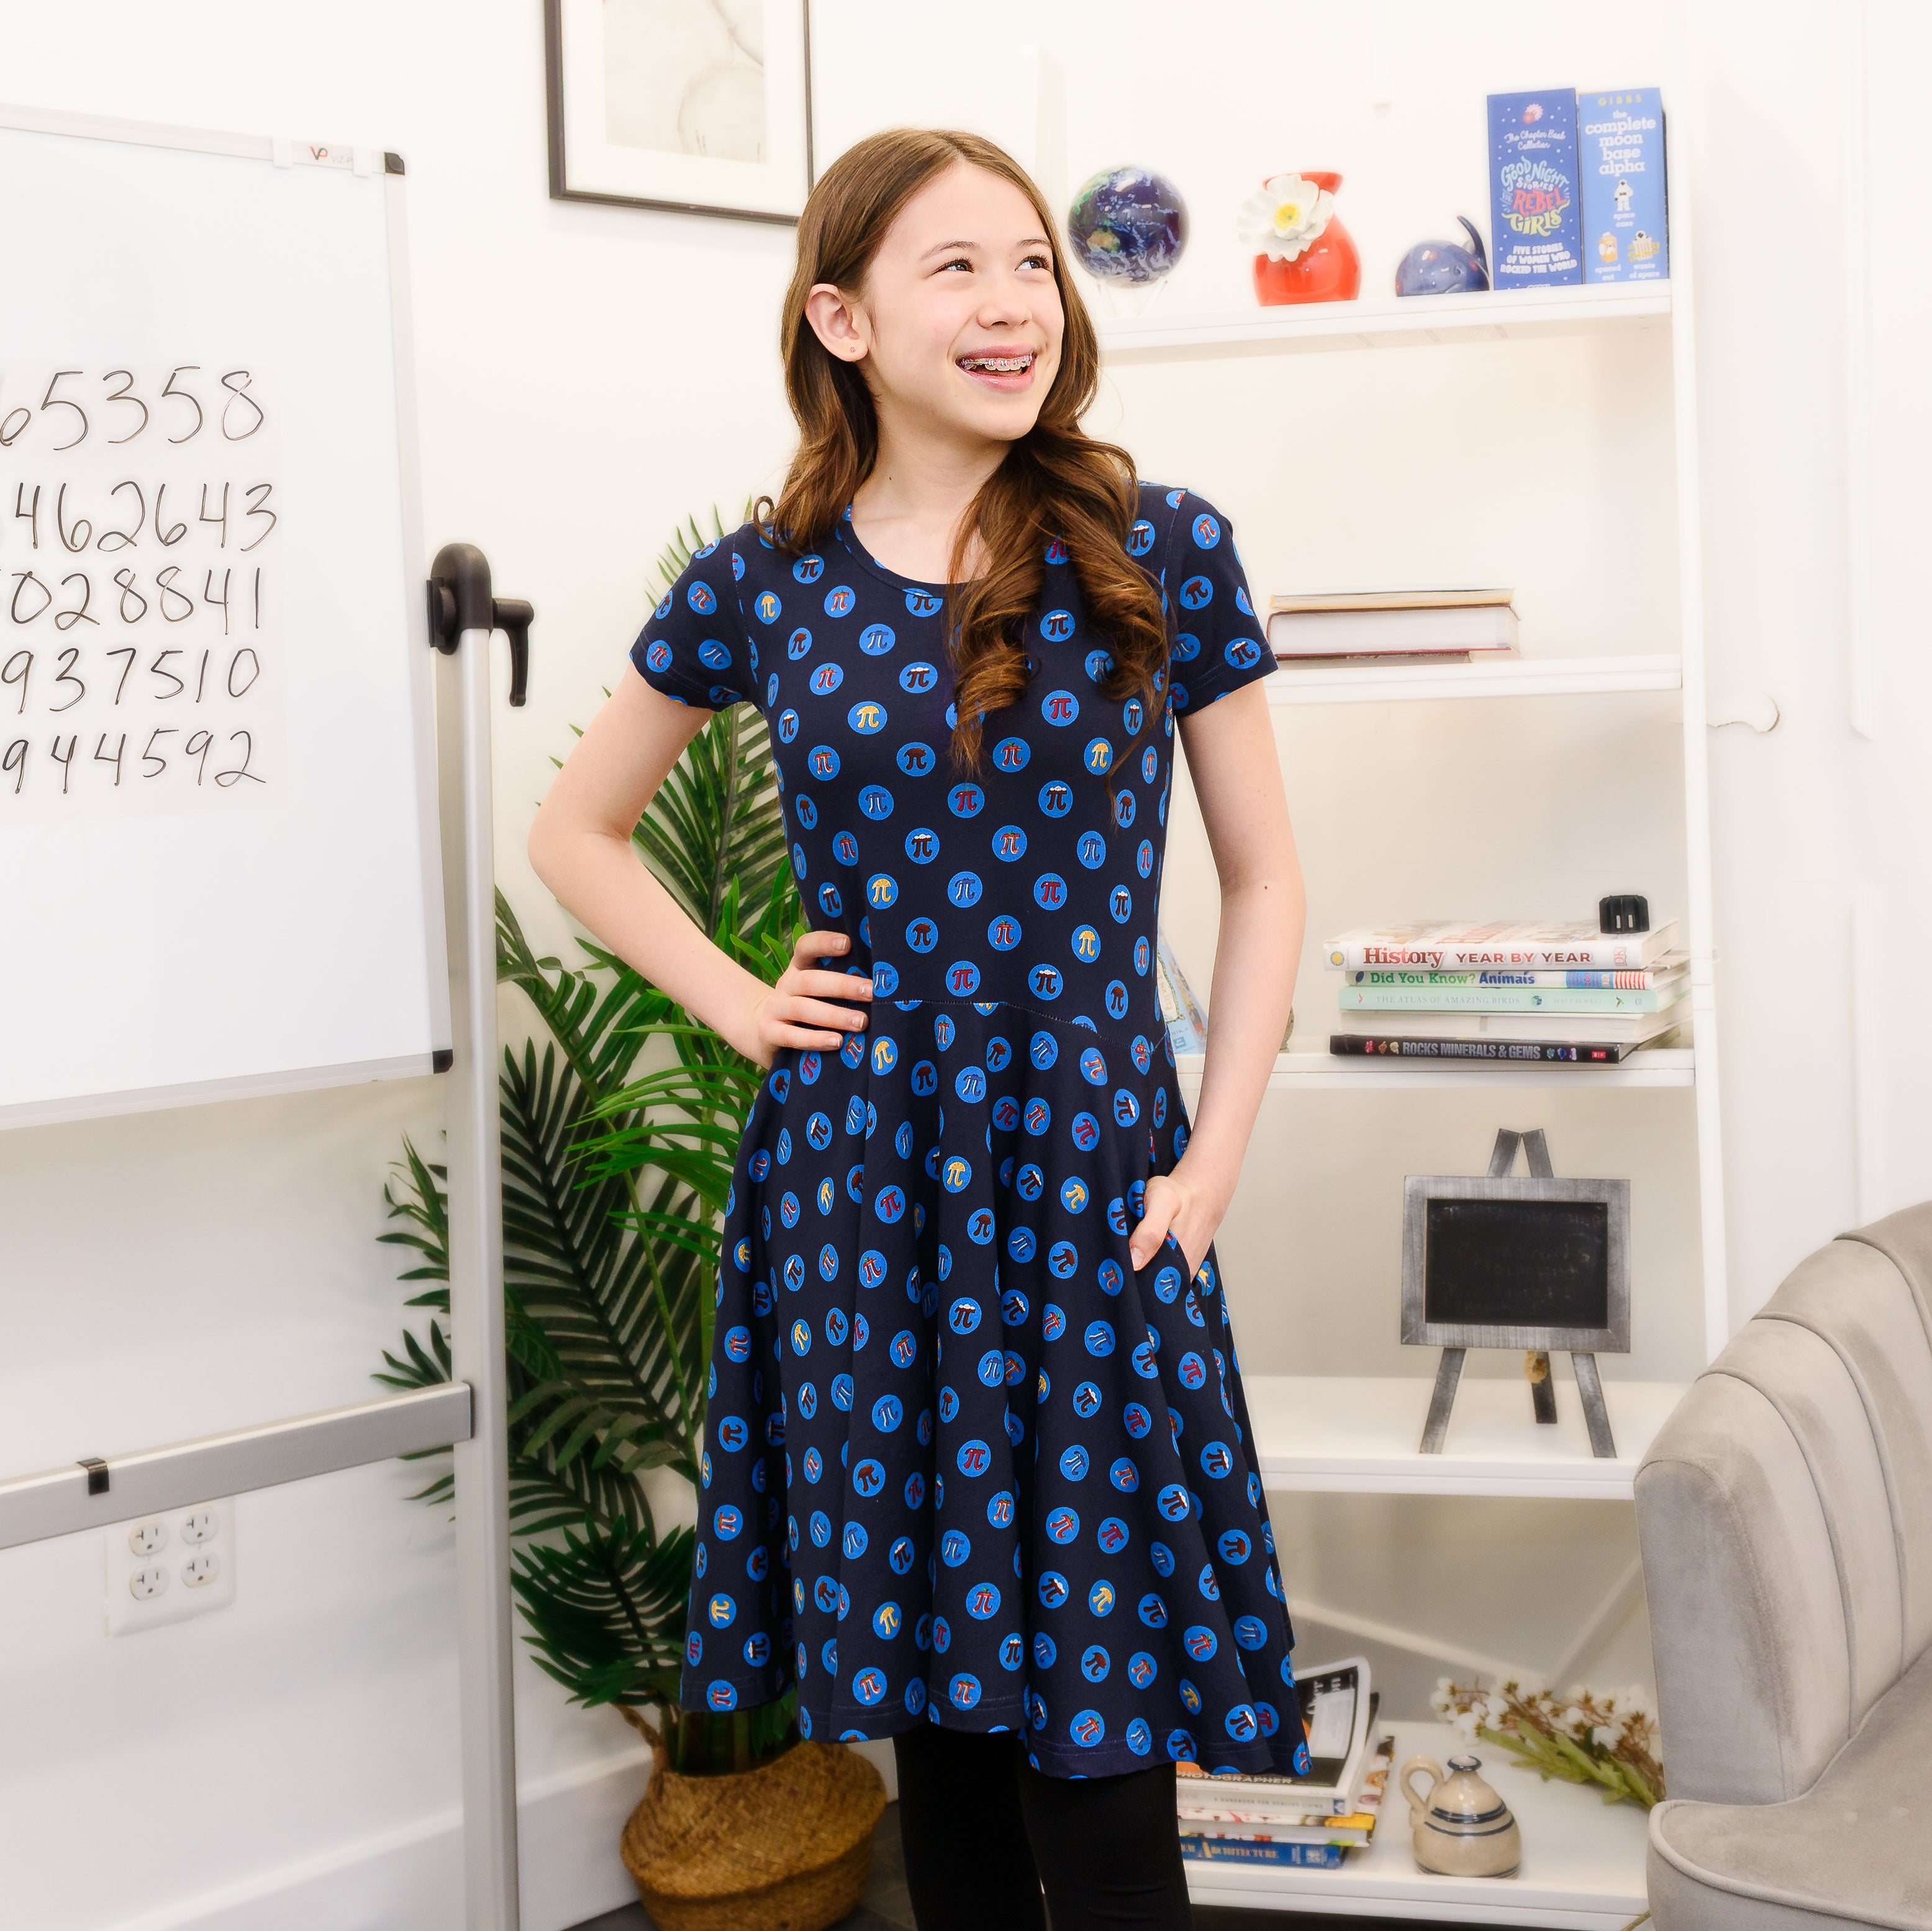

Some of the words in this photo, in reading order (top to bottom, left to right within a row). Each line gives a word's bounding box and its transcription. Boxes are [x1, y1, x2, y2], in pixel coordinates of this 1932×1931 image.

[1613, 110, 1627, 119] the
[1585, 117, 1656, 135] complete
[1599, 134, 1643, 147] moon
[1602, 147, 1641, 161] base
[1599, 159, 1646, 177] alpha
[1512, 188, 1567, 217] REBEL
[16, 481, 277, 553] 462643
[1, 648, 260, 714] 937510
[2, 728, 266, 794] 944592
[1363, 947, 1444, 968] History
[1456, 952, 1504, 963] YEAR
[1510, 952, 1535, 963] BY
[1541, 952, 1591, 962] YEAR
[1370, 972, 1395, 984] Did
[1398, 972, 1425, 984] You
[1428, 972, 1476, 984] Know?
[1479, 972, 1535, 985] Animals
[1376, 995, 1395, 1003] THE
[1444, 996, 1489, 1004] AMAZING
[1492, 997, 1520, 1005] BIRDS
[1402, 1041, 1438, 1056] ROCKS
[1441, 1042, 1496, 1058] MINERALS
[1498, 1046, 1507, 1058] &
[1508, 1045, 1541, 1059] GEMS
